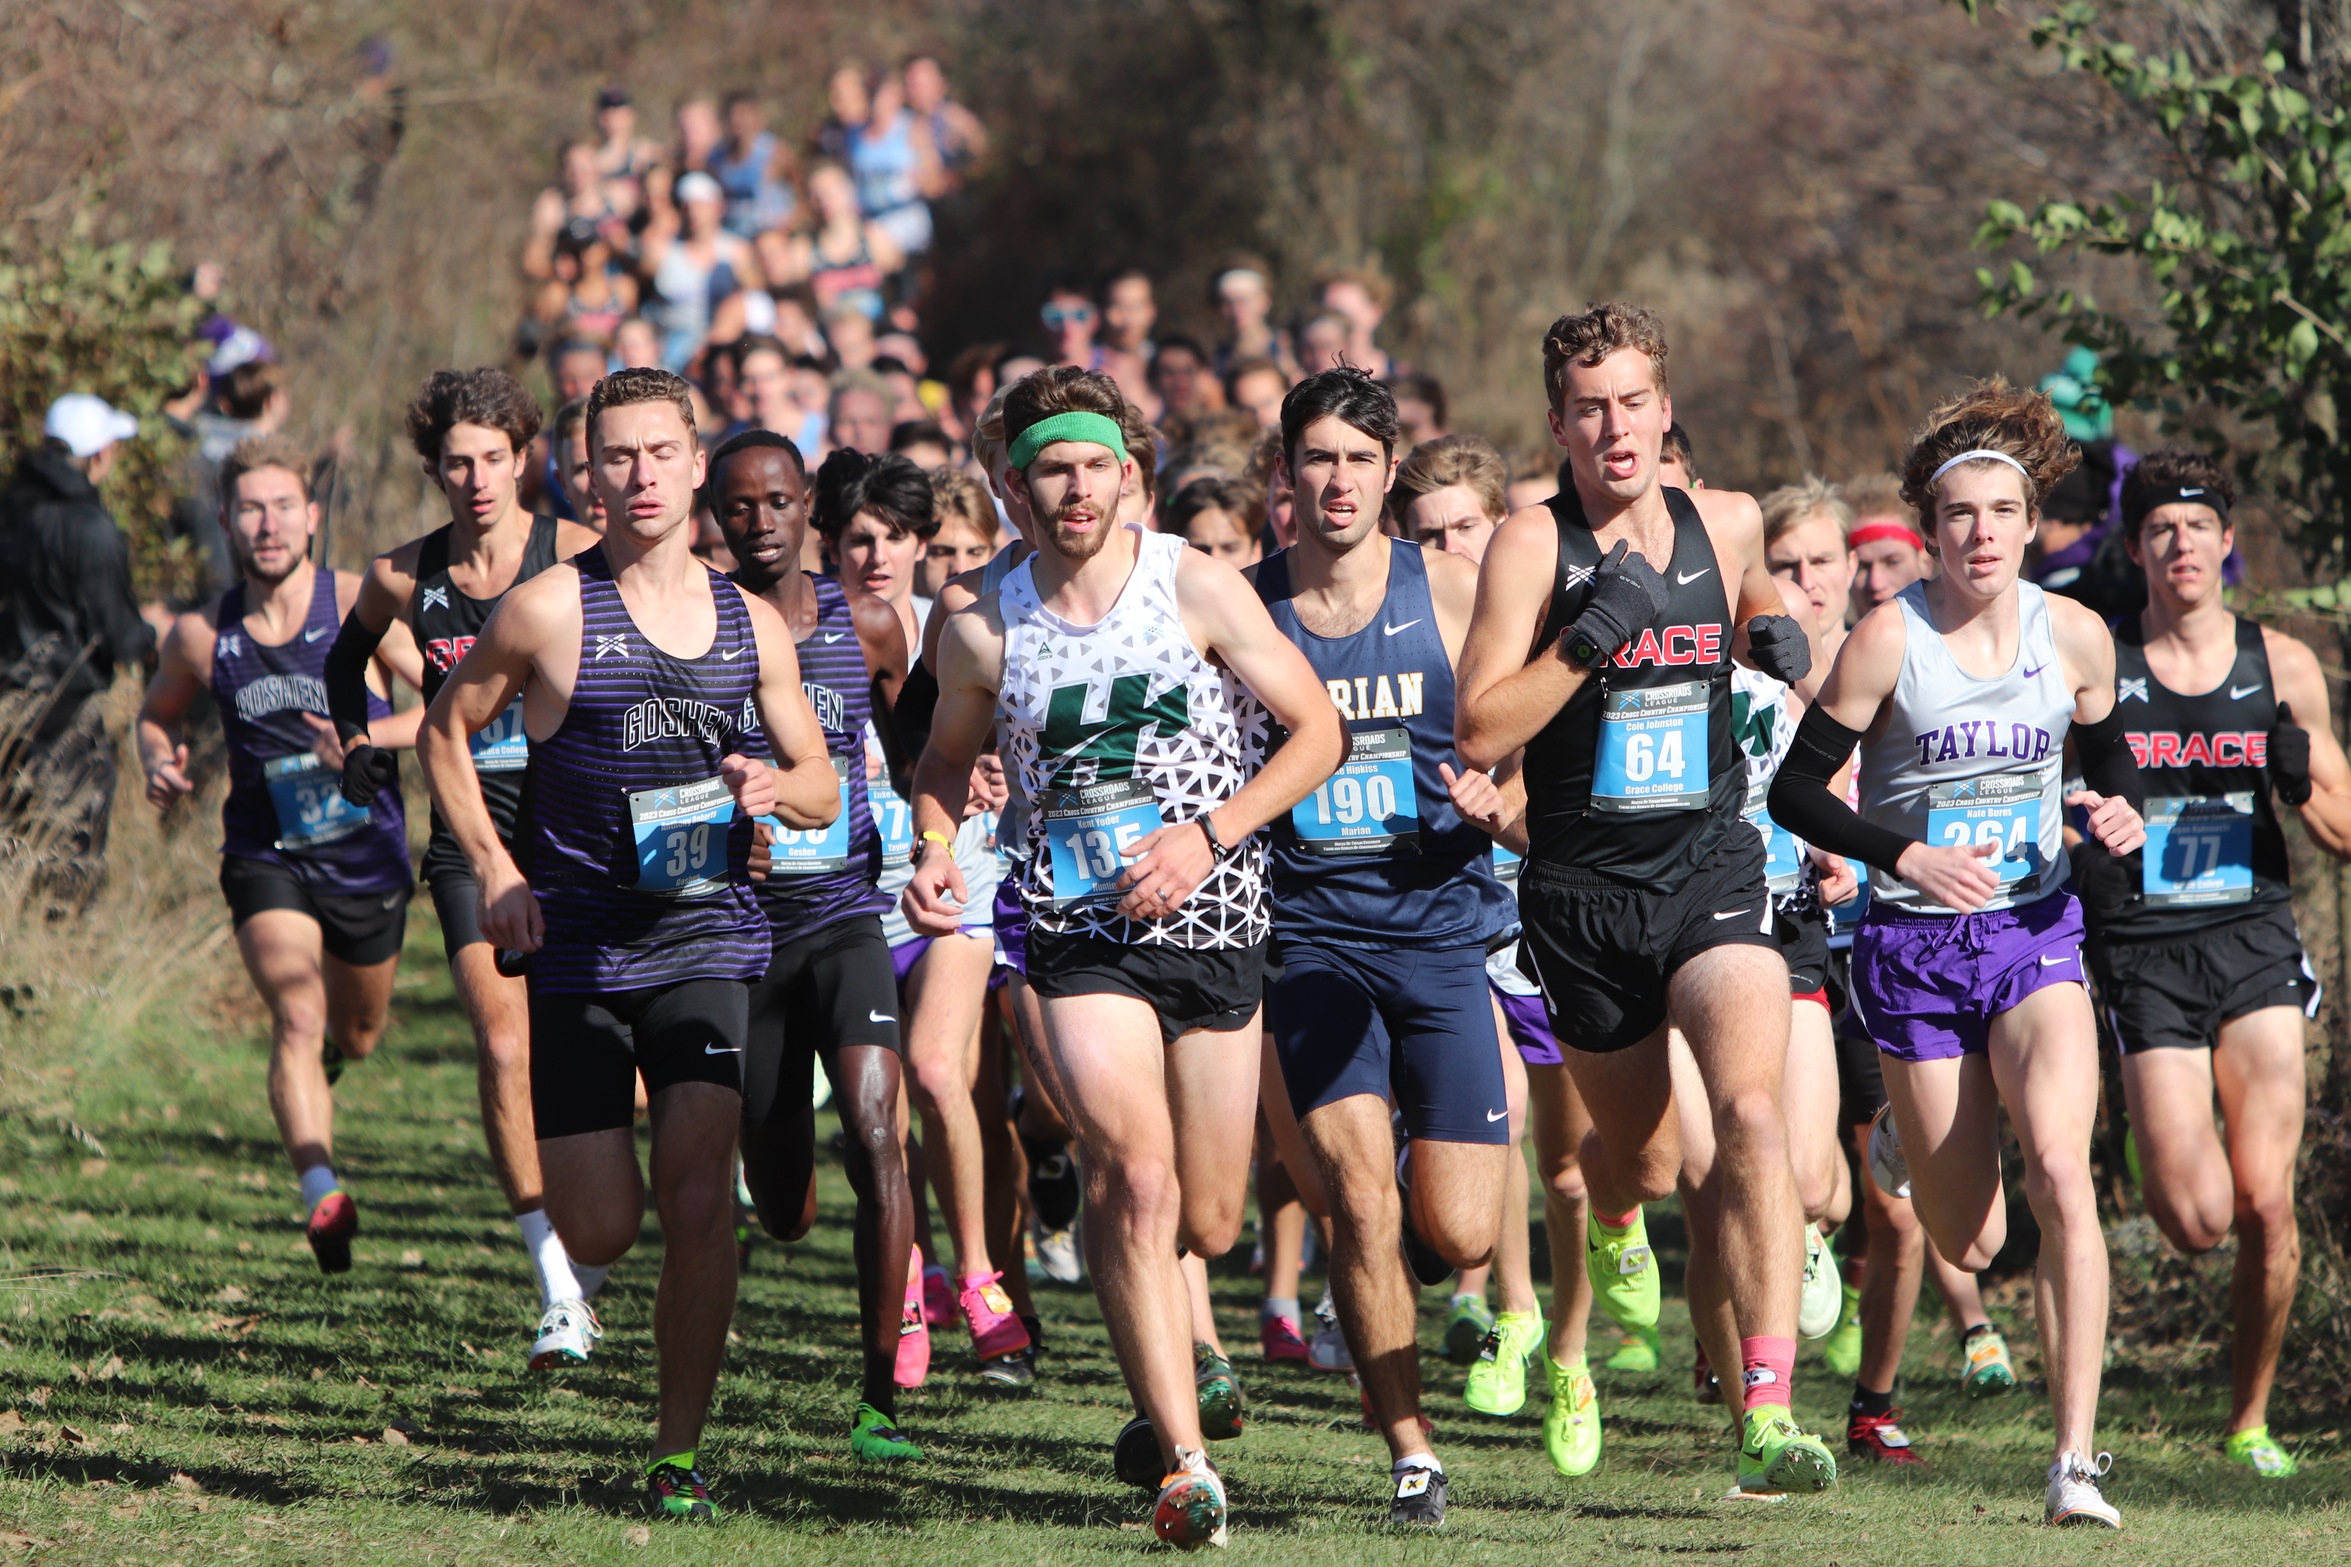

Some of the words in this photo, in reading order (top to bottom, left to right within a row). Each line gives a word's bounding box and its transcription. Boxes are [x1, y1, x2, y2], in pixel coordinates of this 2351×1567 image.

[1560, 624, 1722, 668] RACE
[236, 674, 331, 722] GOSHEN
[1326, 672, 1424, 720] RIAN
[1645, 686, 1692, 701] CROSSROADS
[1645, 698, 1678, 707] LEAGUE
[1603, 711, 1621, 719] 2023
[623, 698, 732, 752] GOSHEN
[1626, 721, 1644, 731] Cole
[1646, 718, 1683, 730] Johnston
[1914, 720, 2051, 767] TAYLOR
[2124, 731, 2268, 769] GRACE
[1625, 730, 1686, 782] 64
[1346, 764, 1378, 775] Hipkiss
[679, 780, 720, 799] CROSSROADS
[1080, 782, 1130, 799] CROSSROADS
[1625, 785, 1650, 795] Grace
[1652, 783, 1684, 794] College
[1980, 775, 2025, 790] CROSSROADS
[680, 793, 709, 805] LEAGUE
[1081, 795, 1116, 805] LEAGUE
[1313, 775, 1396, 824] 190
[1980, 788, 2013, 796] LEAGUE
[296, 783, 346, 824] 32
[1936, 800, 1955, 808] 2023
[639, 812, 658, 821] 2023
[661, 817, 692, 831] Anthony
[692, 810, 717, 823] Roberts
[868, 801, 914, 842] 27
[1048, 810, 1063, 818] 2023
[1967, 809, 1986, 819] Nate
[1987, 808, 2013, 817] Burns
[1077, 819, 1094, 829] Kent
[1095, 815, 1120, 827] Yoder
[1341, 827, 1371, 836] Marian
[666, 823, 710, 877] 39
[1944, 816, 2028, 868] 264
[788, 848, 817, 857] Goshen
[1065, 822, 1149, 880] 135
[2178, 836, 2221, 877] 77
